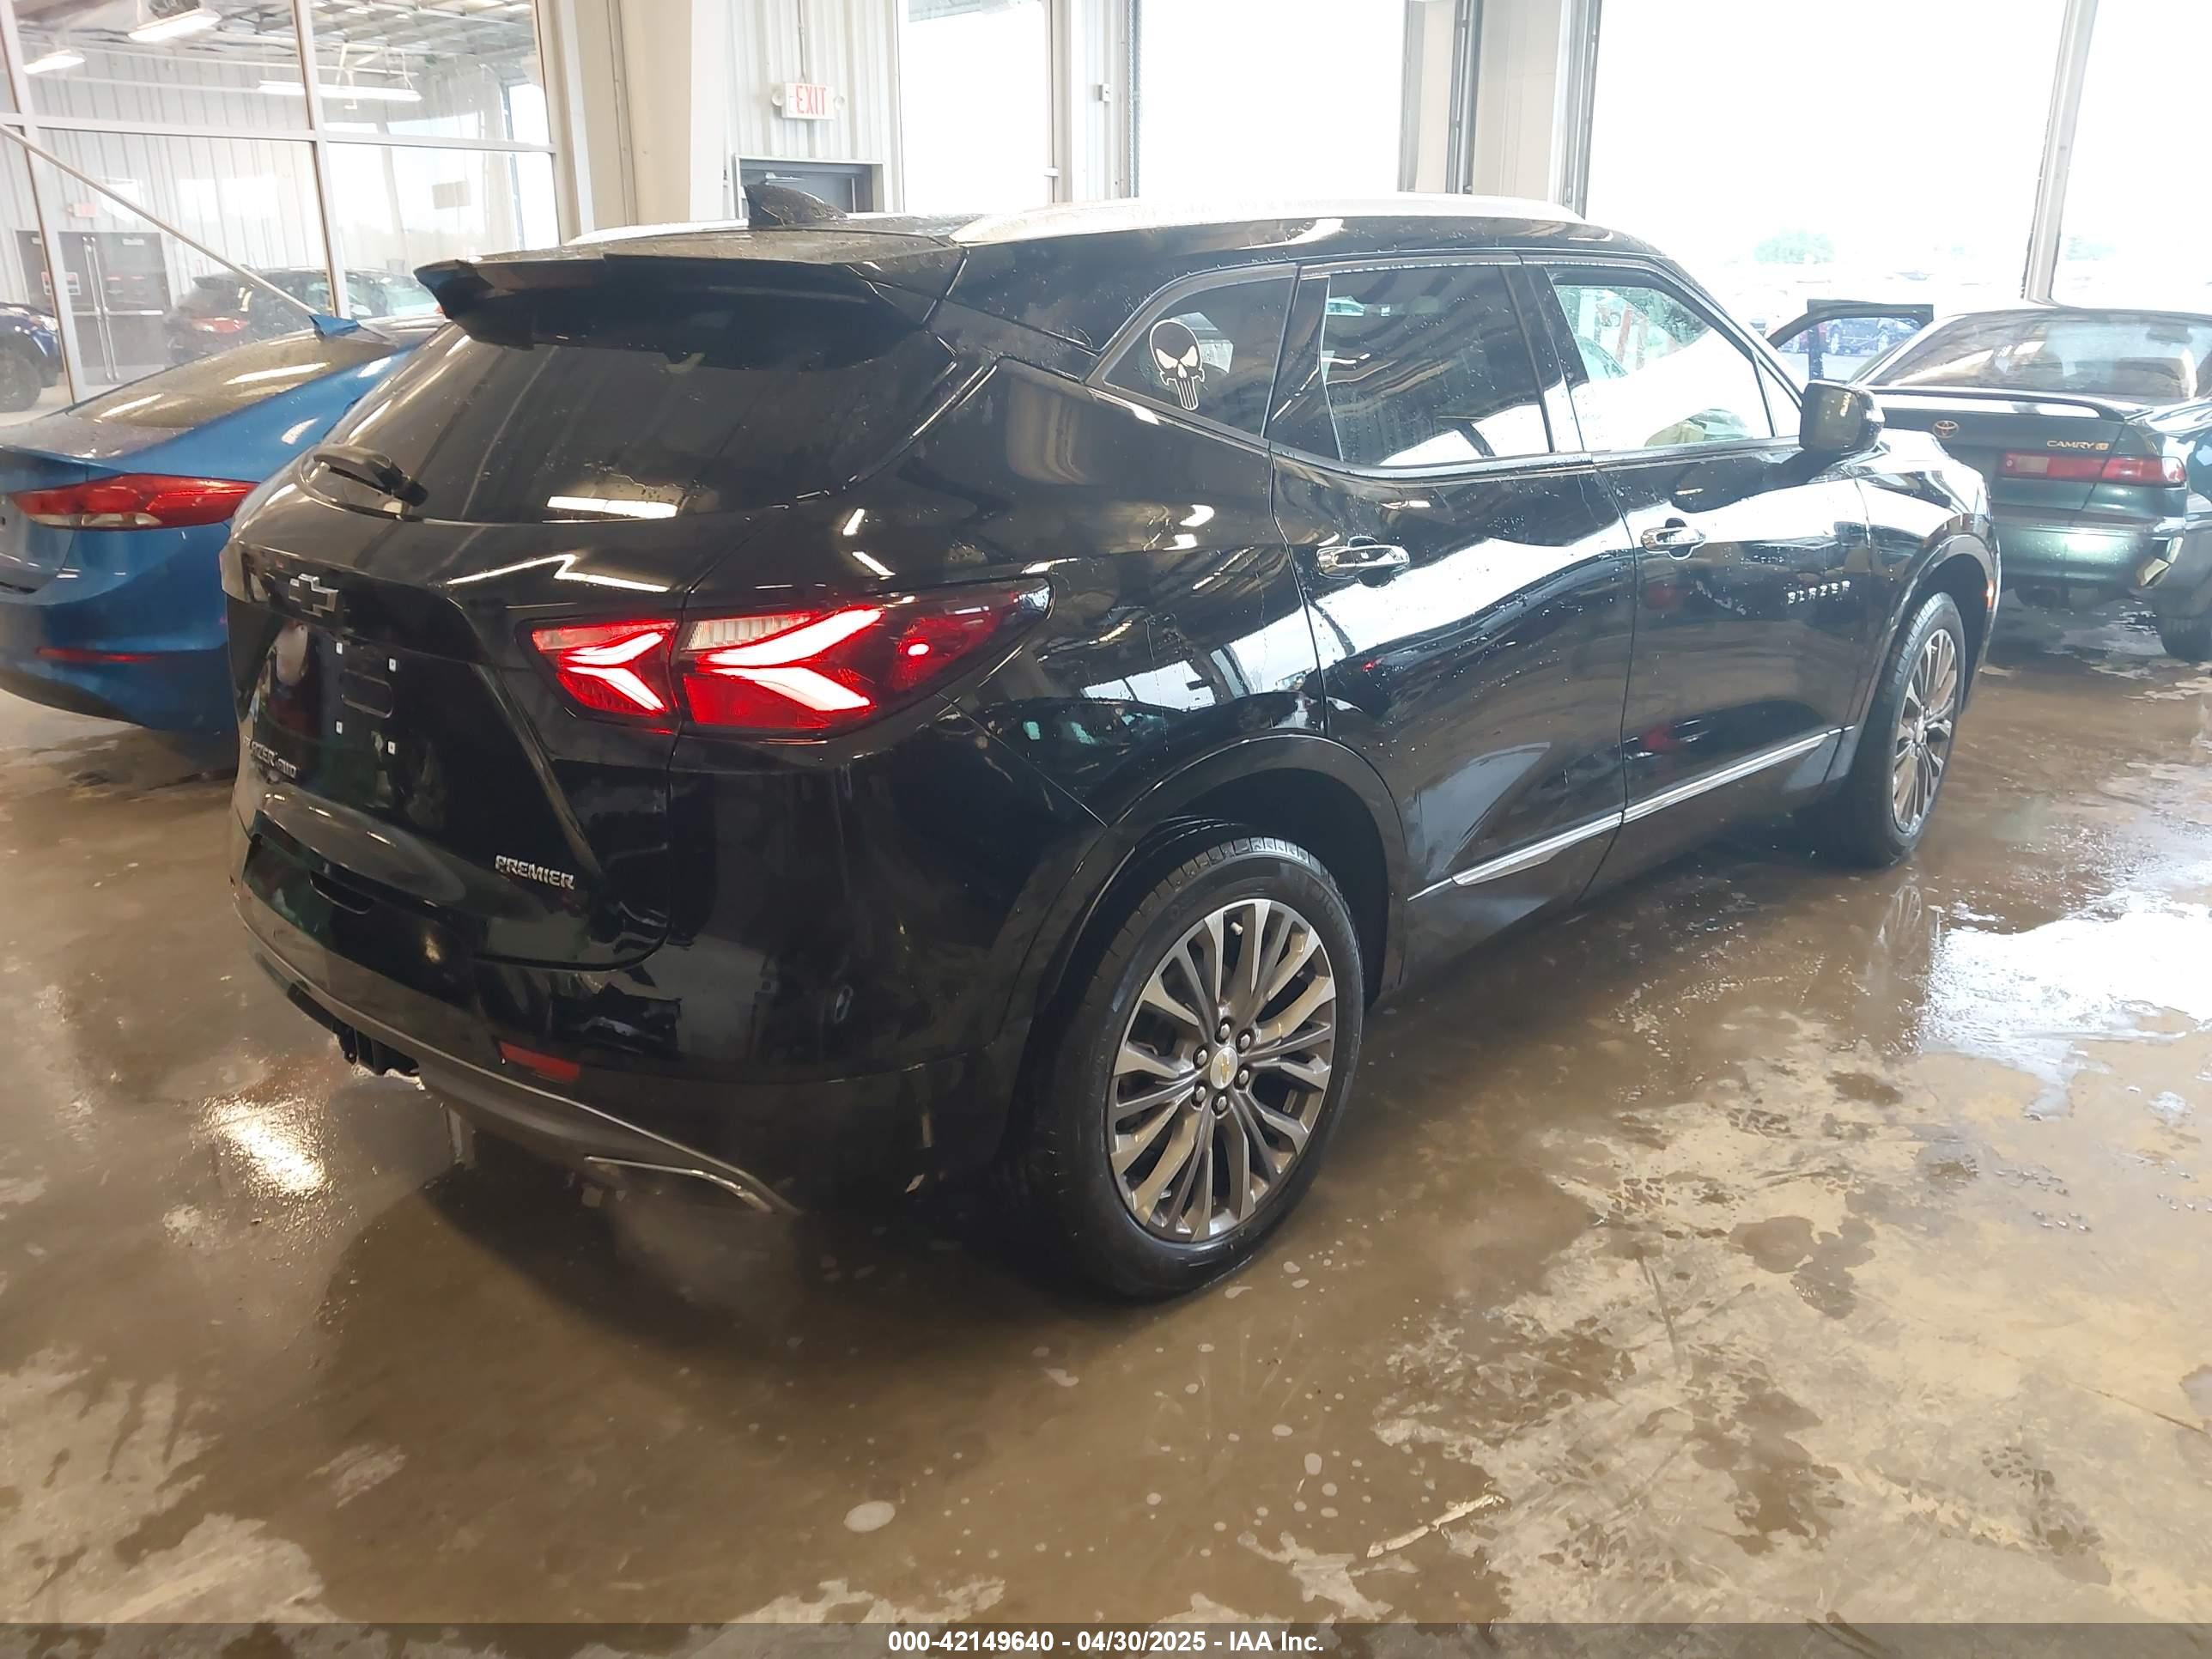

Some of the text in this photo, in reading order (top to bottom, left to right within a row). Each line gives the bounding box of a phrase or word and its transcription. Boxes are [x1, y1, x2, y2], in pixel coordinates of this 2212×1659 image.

[796, 85, 825, 115] EXIT
[2046, 440, 2094, 449] CAMRY
[495, 854, 574, 890] PREMIER
